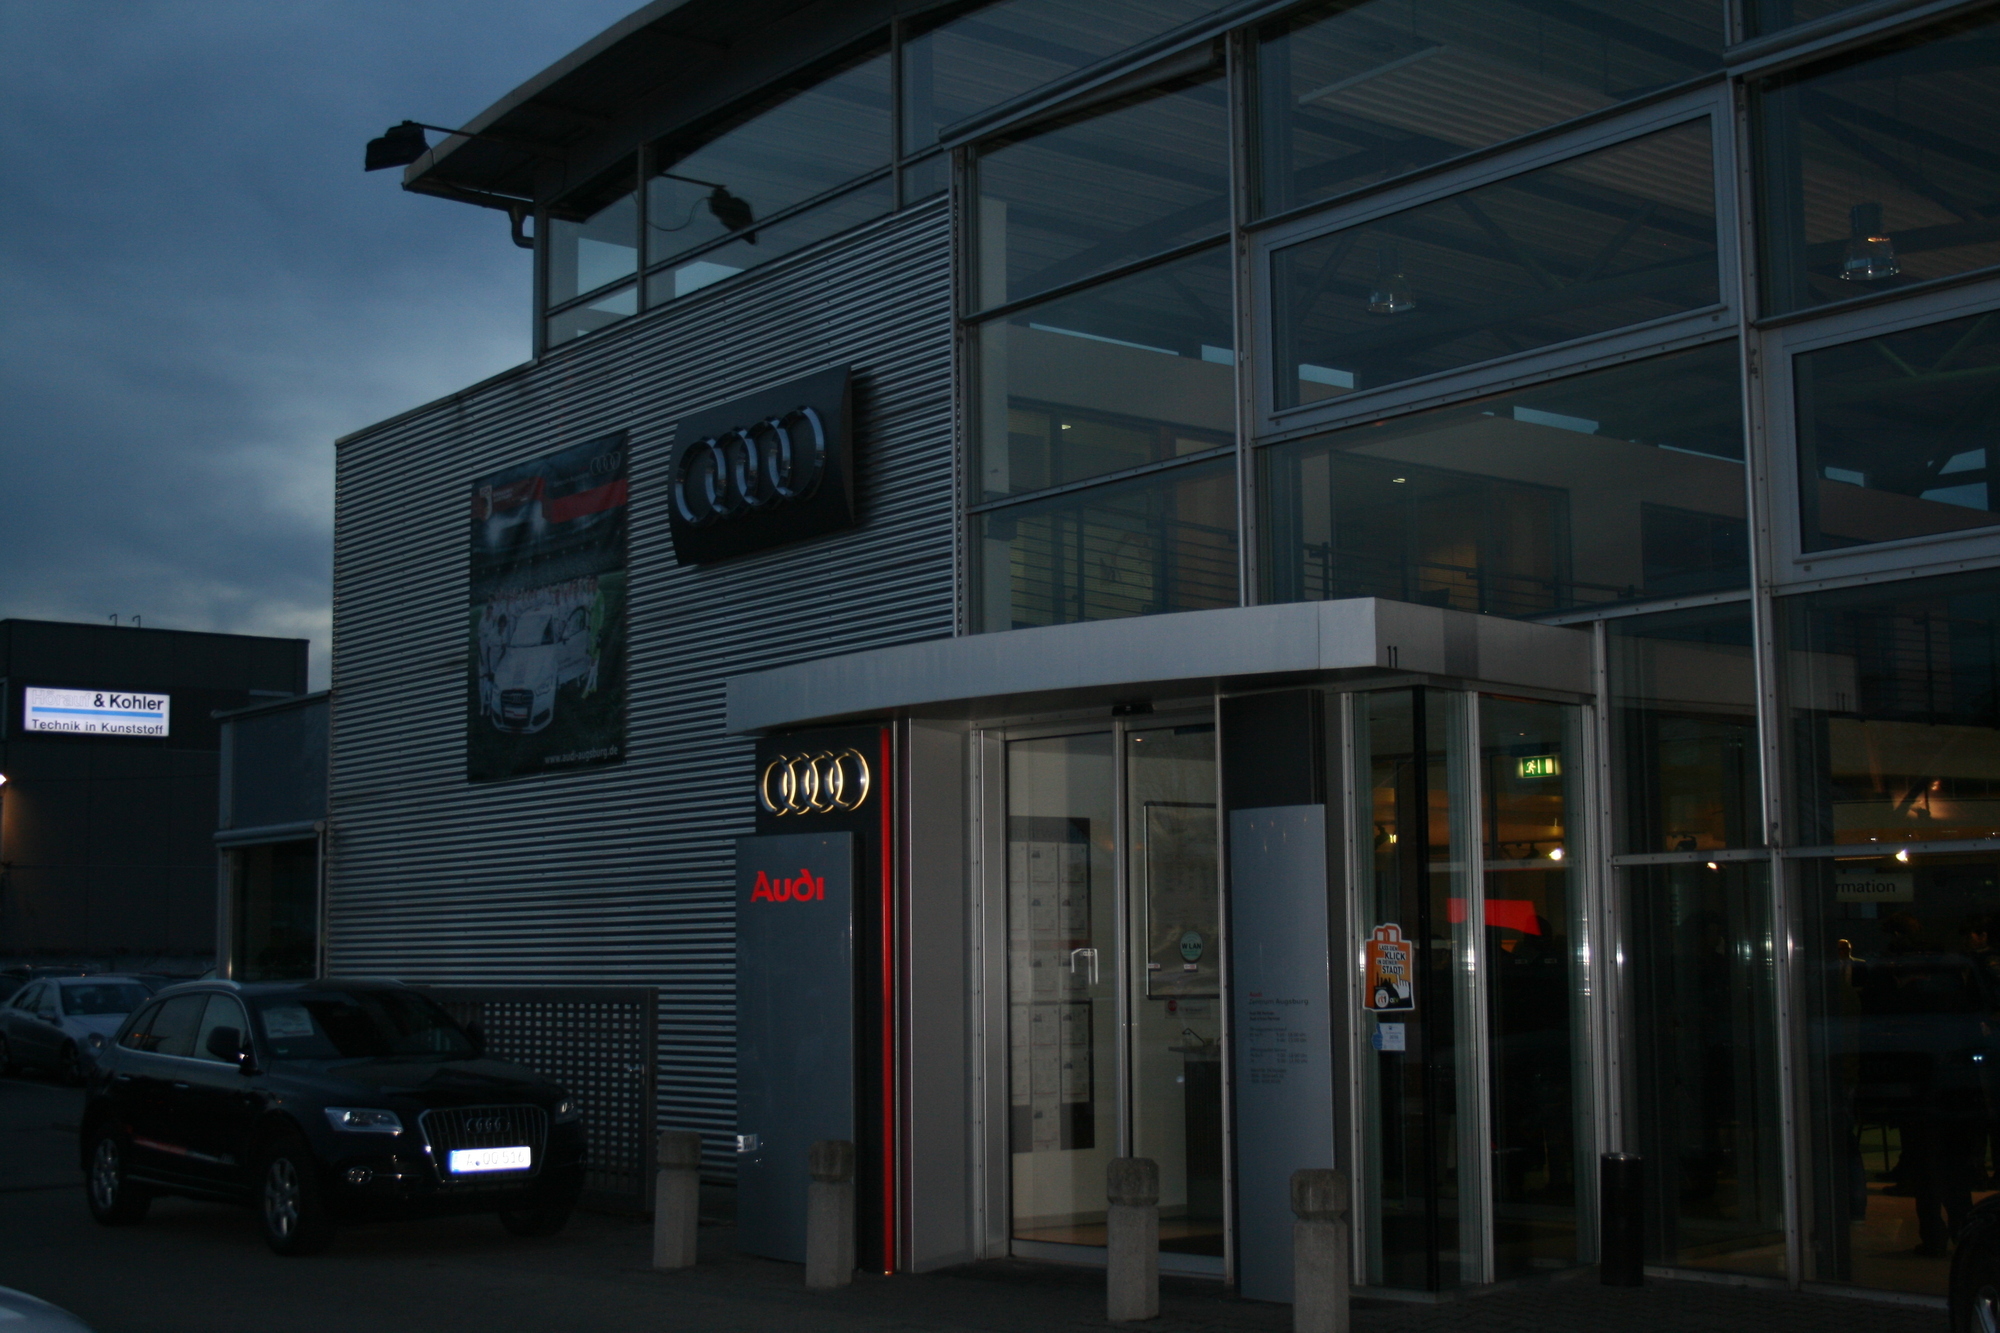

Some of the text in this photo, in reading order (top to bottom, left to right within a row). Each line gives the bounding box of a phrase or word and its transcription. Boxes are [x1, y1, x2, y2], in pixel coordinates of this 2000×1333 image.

[94, 693, 106, 708] &
[110, 694, 164, 710] Kohler
[32, 718, 164, 735] Technik in Kunststoff
[544, 744, 619, 764] www.audi-augsburg.de
[750, 868, 826, 903] Audi
[1384, 951, 1406, 961] KLICK
[1382, 965, 1404, 974] STADT!
[1275, 998, 1309, 1006] Augsburg
